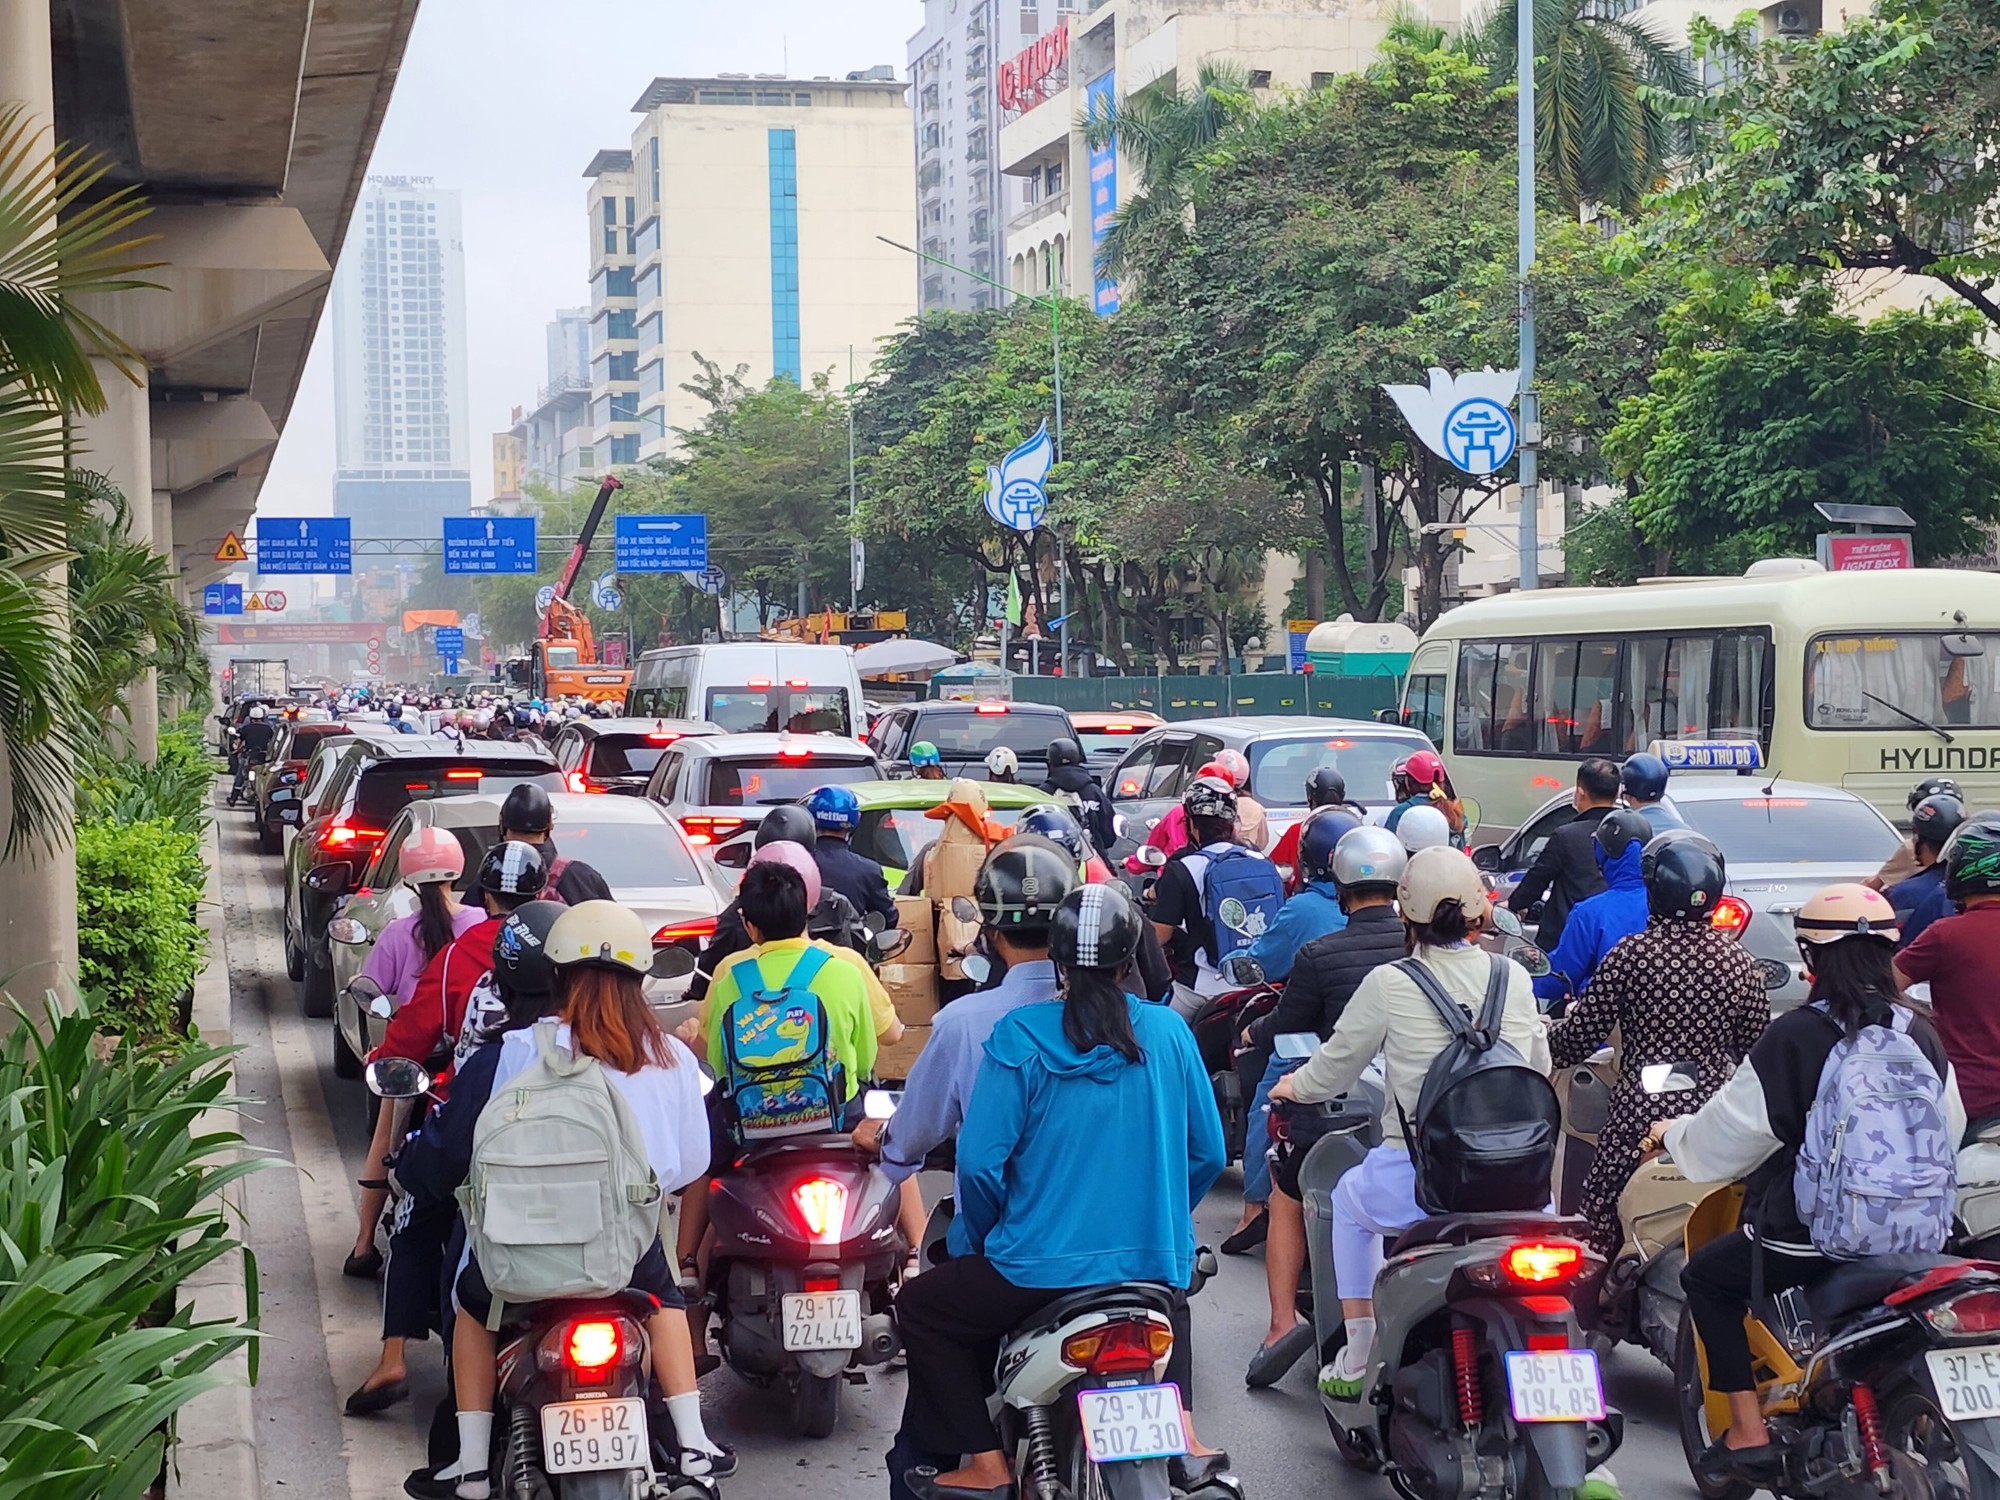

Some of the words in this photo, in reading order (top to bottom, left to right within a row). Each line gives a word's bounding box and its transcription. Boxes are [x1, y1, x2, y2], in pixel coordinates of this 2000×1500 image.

[410, 176, 434, 184] HUY
[340, 539, 350, 547] km
[522, 550, 532, 558] km
[340, 551, 350, 559] km
[340, 562, 350, 570] km
[523, 562, 533, 570] km
[1841, 561, 1874, 571] LIGHT
[1874, 558, 1901, 569] BOX
[1688, 749, 1711, 765] SAO
[513, 922, 542, 947] BLUE
[795, 1297, 848, 1320] 29-T2
[790, 1321, 855, 1346] 224.44
[1520, 1356, 1585, 1384] 36-L6
[1944, 1352, 2000, 1382] 37-E
[575, 1391, 609, 1400] HONDA
[1519, 1387, 1598, 1416] 194.85
[1095, 1391, 1163, 1424] 29-X7
[558, 1405, 630, 1436] 26-B2
[1092, 1421, 1181, 1456] 502.30
[553, 1434, 640, 1467] 859.97
